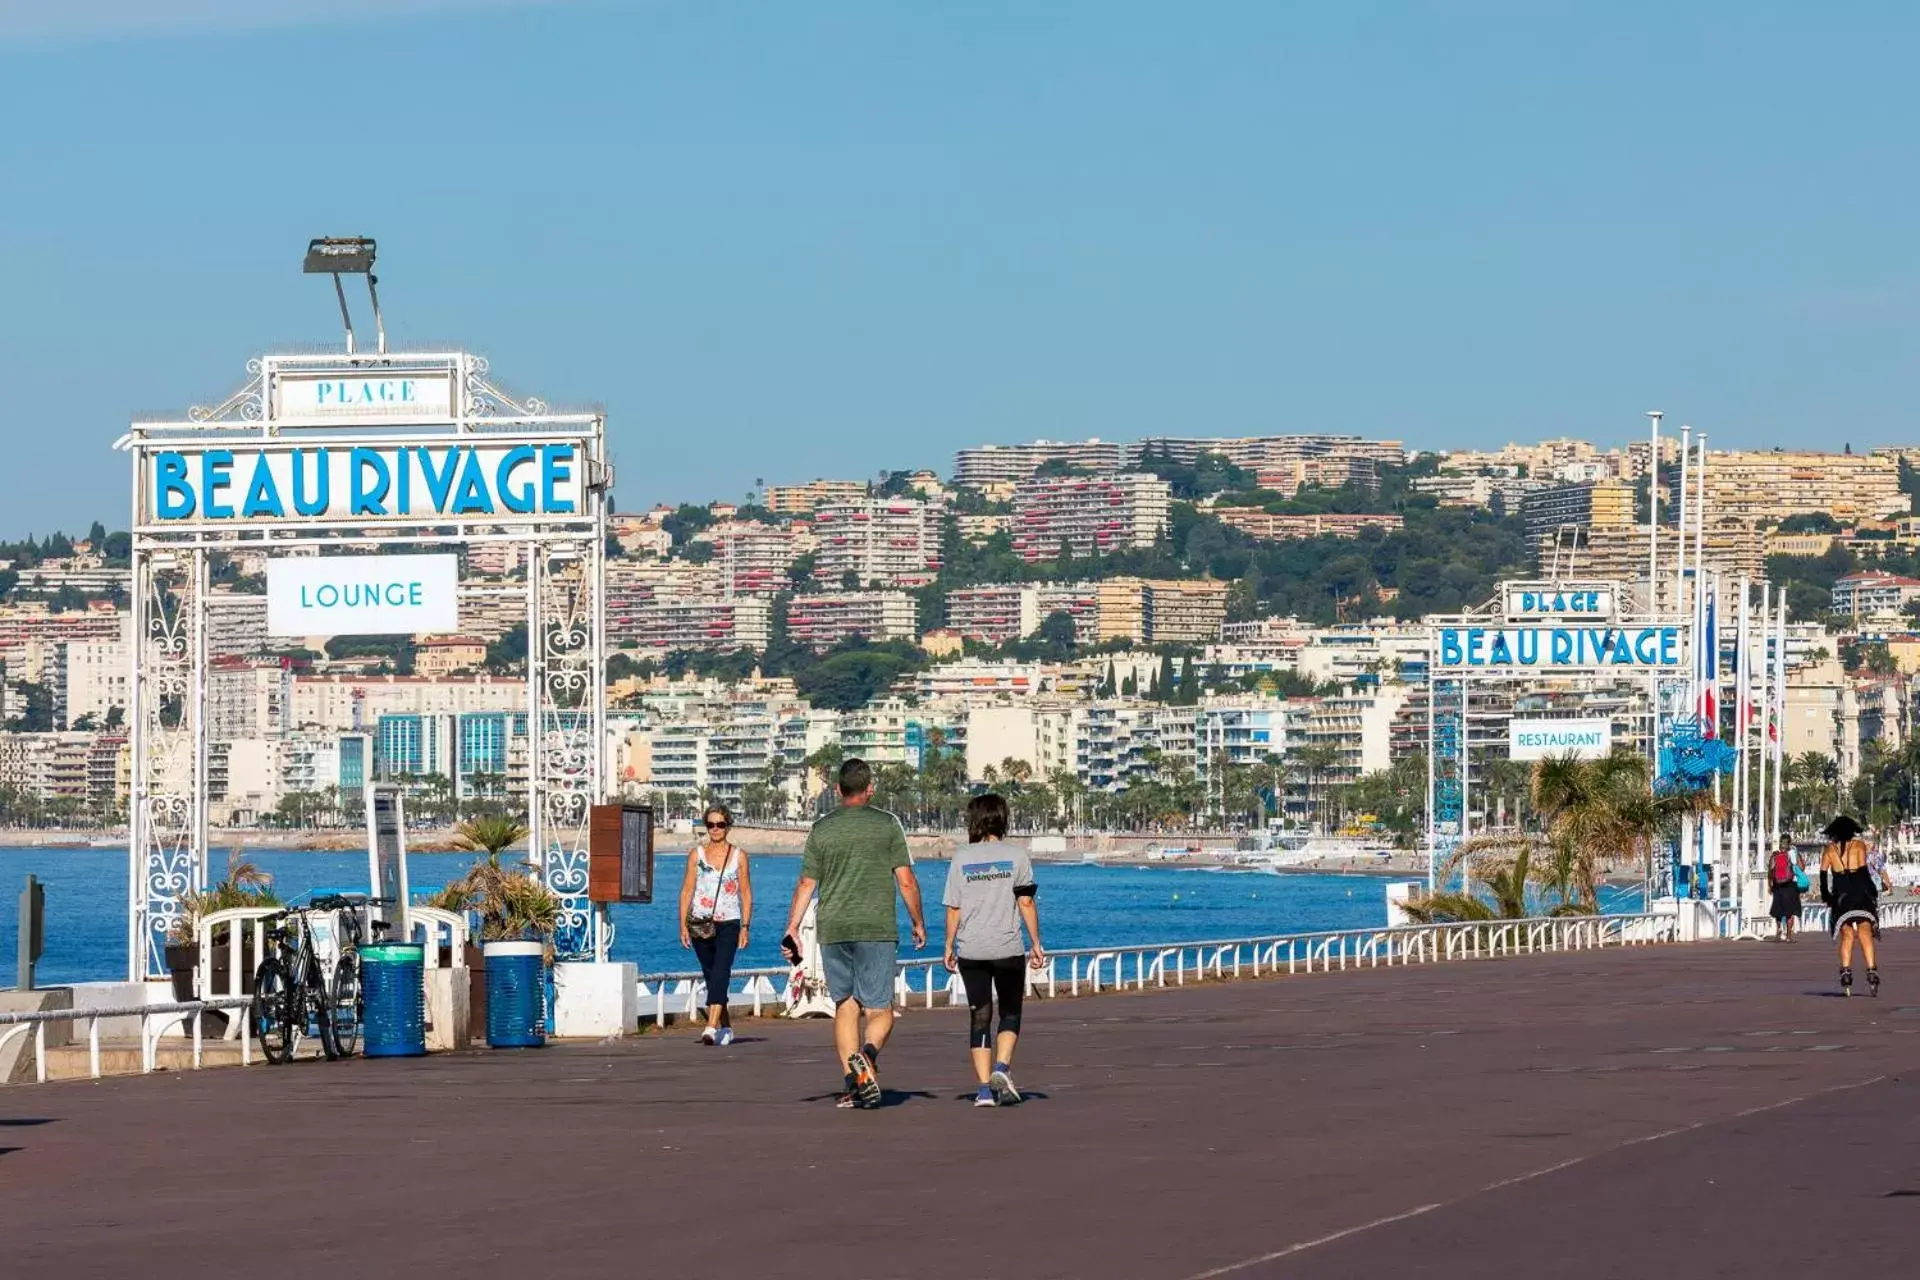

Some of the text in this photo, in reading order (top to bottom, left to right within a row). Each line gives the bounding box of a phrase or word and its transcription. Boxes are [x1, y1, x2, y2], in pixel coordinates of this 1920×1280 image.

[317, 380, 416, 403] PLAGE
[156, 443, 576, 519] BEAU RIVAGE
[301, 582, 423, 608] LOUNGE
[1522, 591, 1599, 612] PLAGE
[1442, 628, 1678, 665] BEAU RIVAGE
[1518, 733, 1602, 746] RESTAURANT
[967, 871, 1011, 882] patagonia
